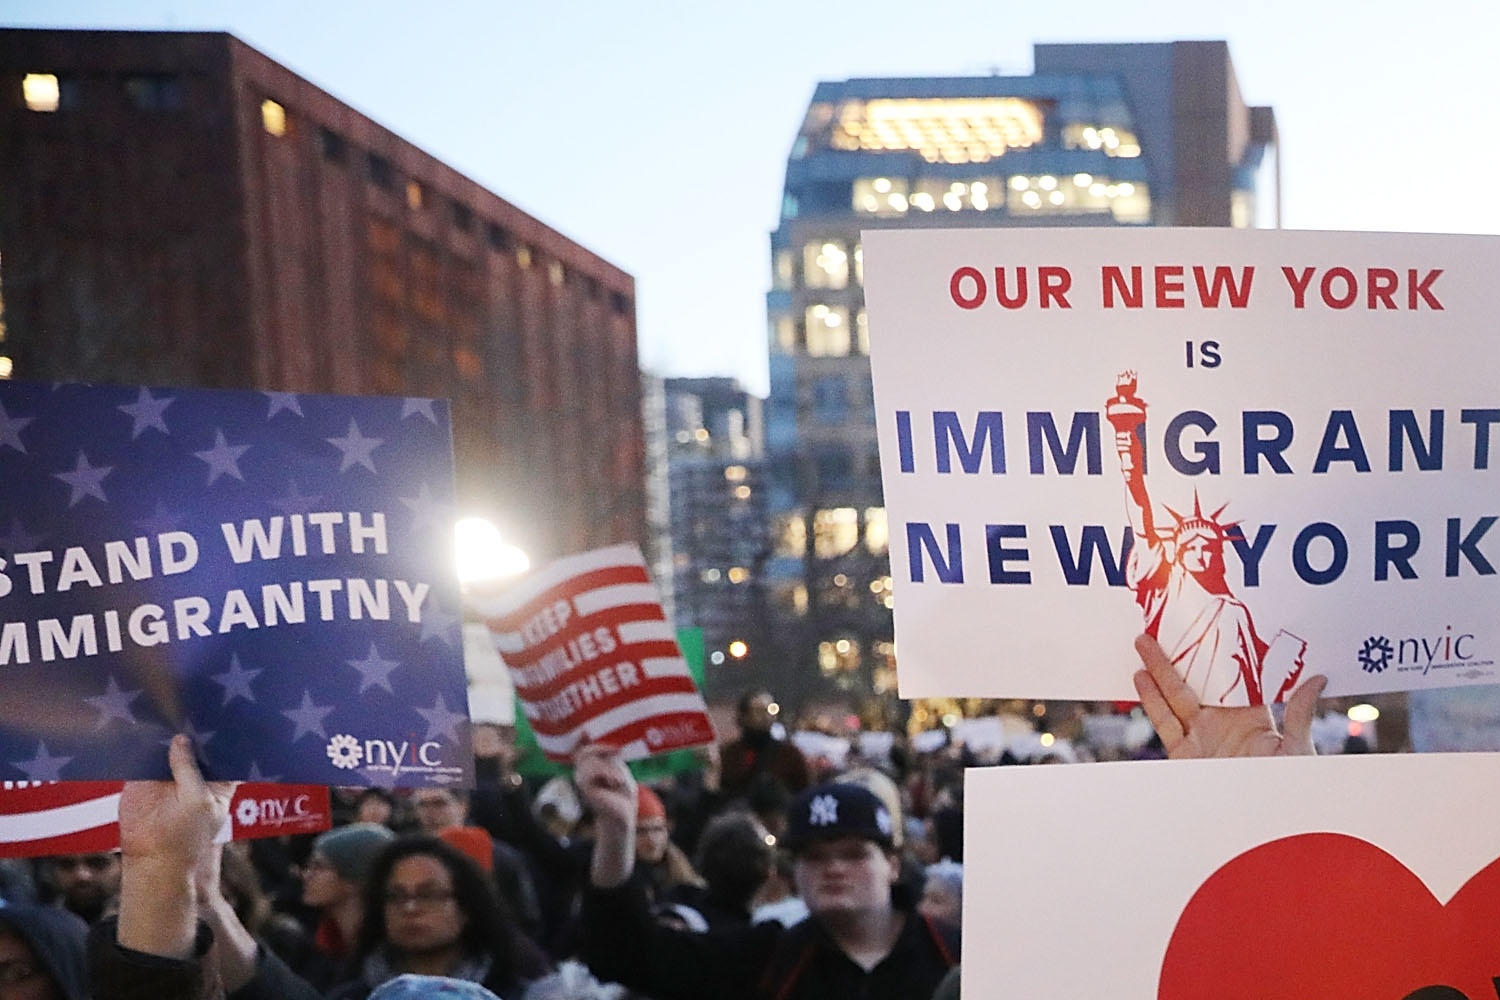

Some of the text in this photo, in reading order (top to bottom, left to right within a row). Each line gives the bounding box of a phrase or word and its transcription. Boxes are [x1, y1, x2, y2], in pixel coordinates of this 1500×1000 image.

[950, 266, 1445, 310] OUR NEW YORK
[1185, 341, 1222, 368] IS
[221, 511, 389, 564] WITH
[905, 515, 1499, 588] NEW YORK
[1398, 625, 1474, 675] nyic
[365, 731, 442, 776] nyic
[260, 794, 310, 828] nyc
